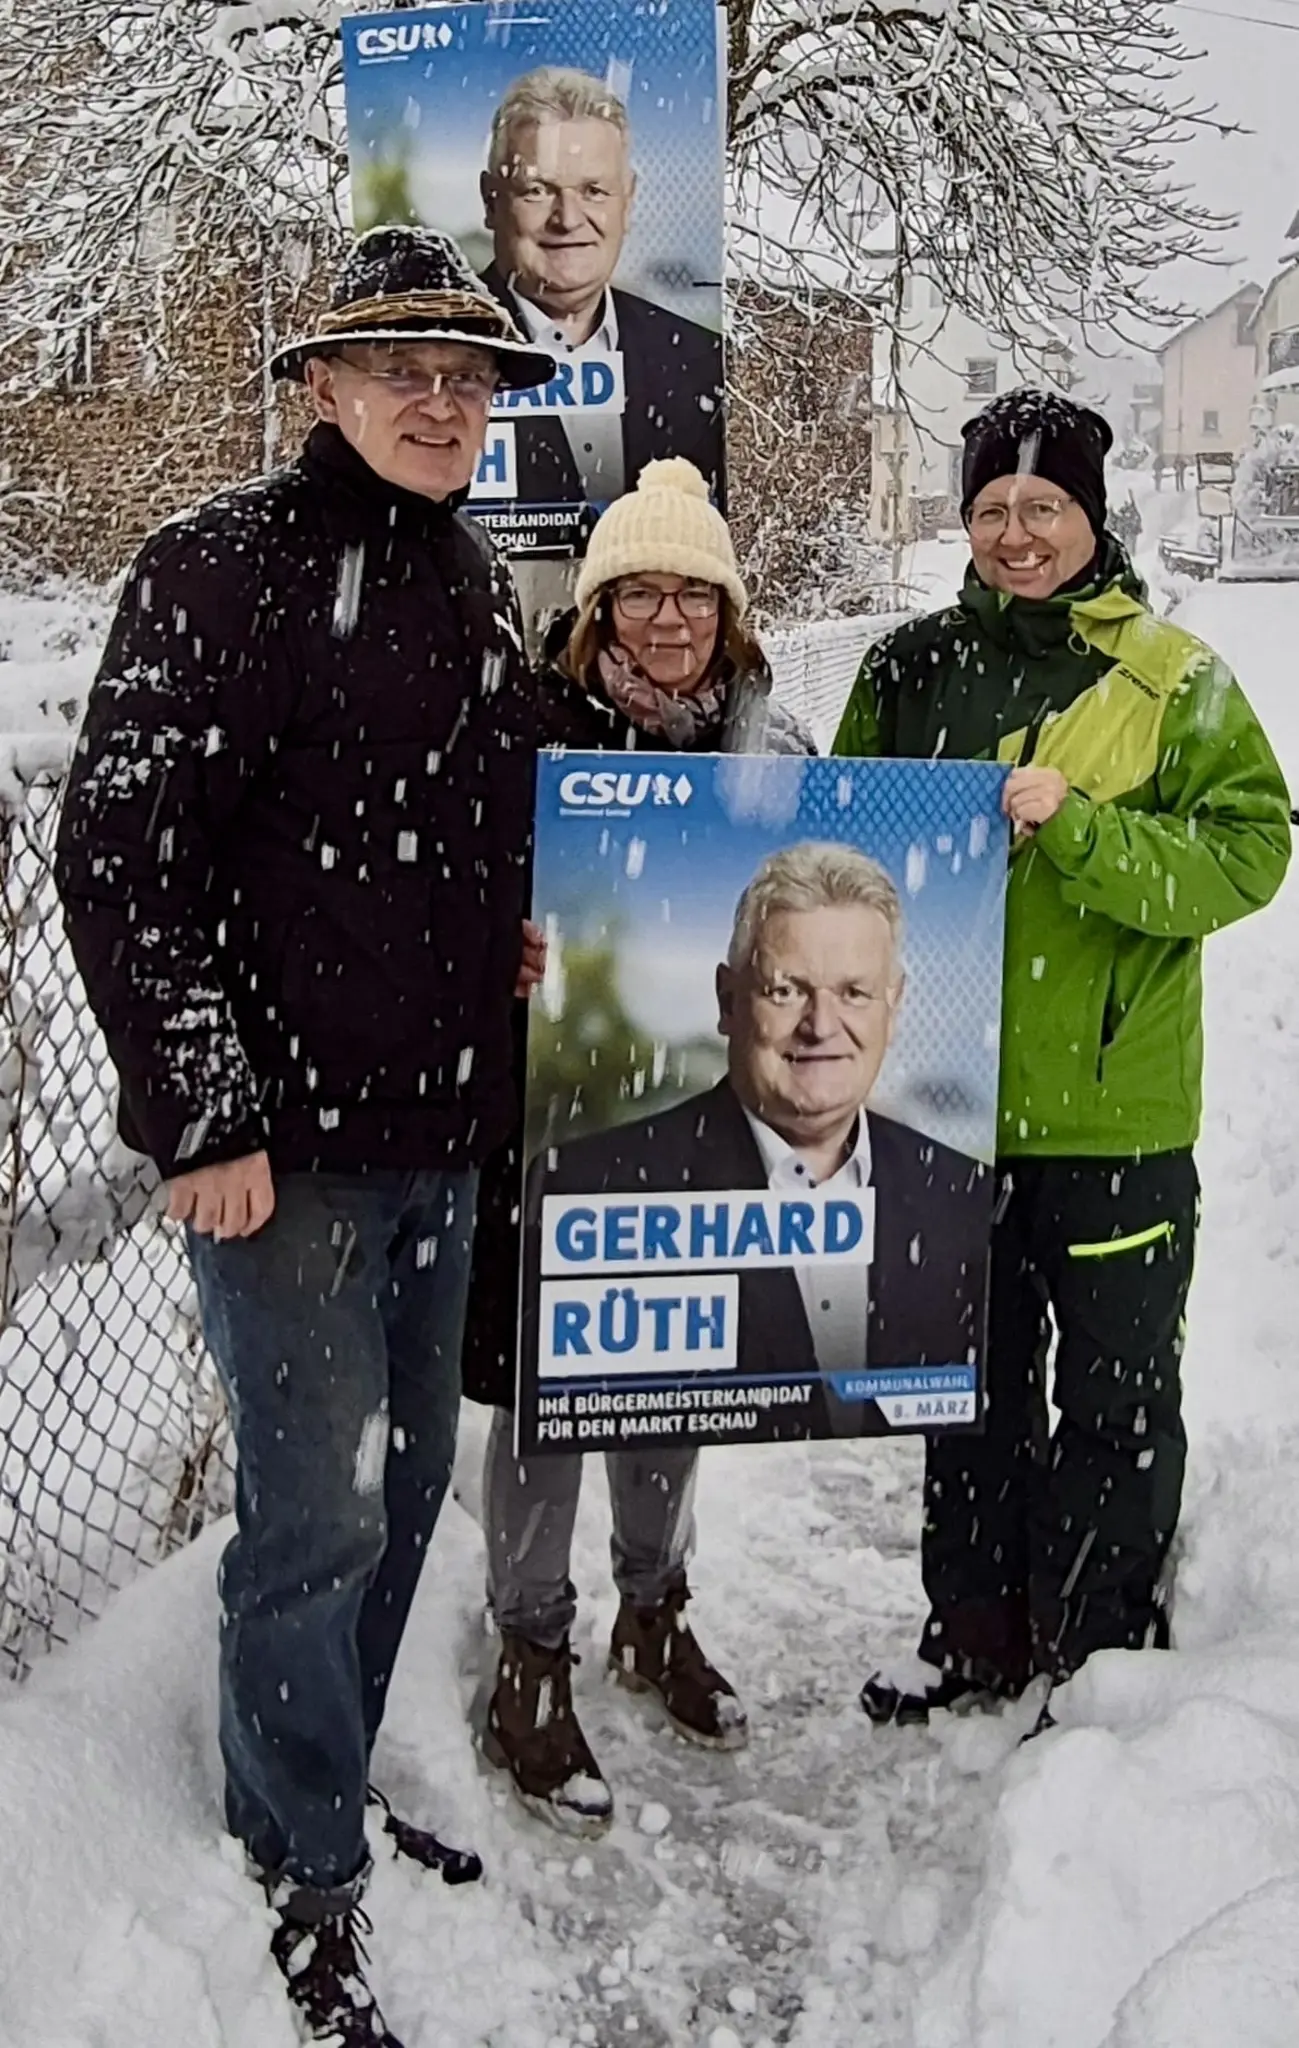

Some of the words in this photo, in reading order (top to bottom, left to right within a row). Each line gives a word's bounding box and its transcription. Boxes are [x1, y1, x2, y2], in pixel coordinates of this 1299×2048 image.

[357, 24, 421, 55] CSU
[476, 438, 507, 483] H
[559, 771, 651, 805] CSU
[555, 1199, 864, 1262] GERHARD
[552, 1288, 726, 1356] RÜTH
[844, 1374, 969, 1394] KOMMUNALWAHL
[538, 1396, 570, 1416] IHR
[575, 1385, 812, 1415] BÜRGERMEISTERKANDIDAT
[916, 1397, 969, 1417] MÄRZ
[538, 1418, 573, 1440] FÜR
[578, 1419, 616, 1437] DEN
[620, 1415, 684, 1435] MARKT
[688, 1410, 758, 1433] ESCHAU
